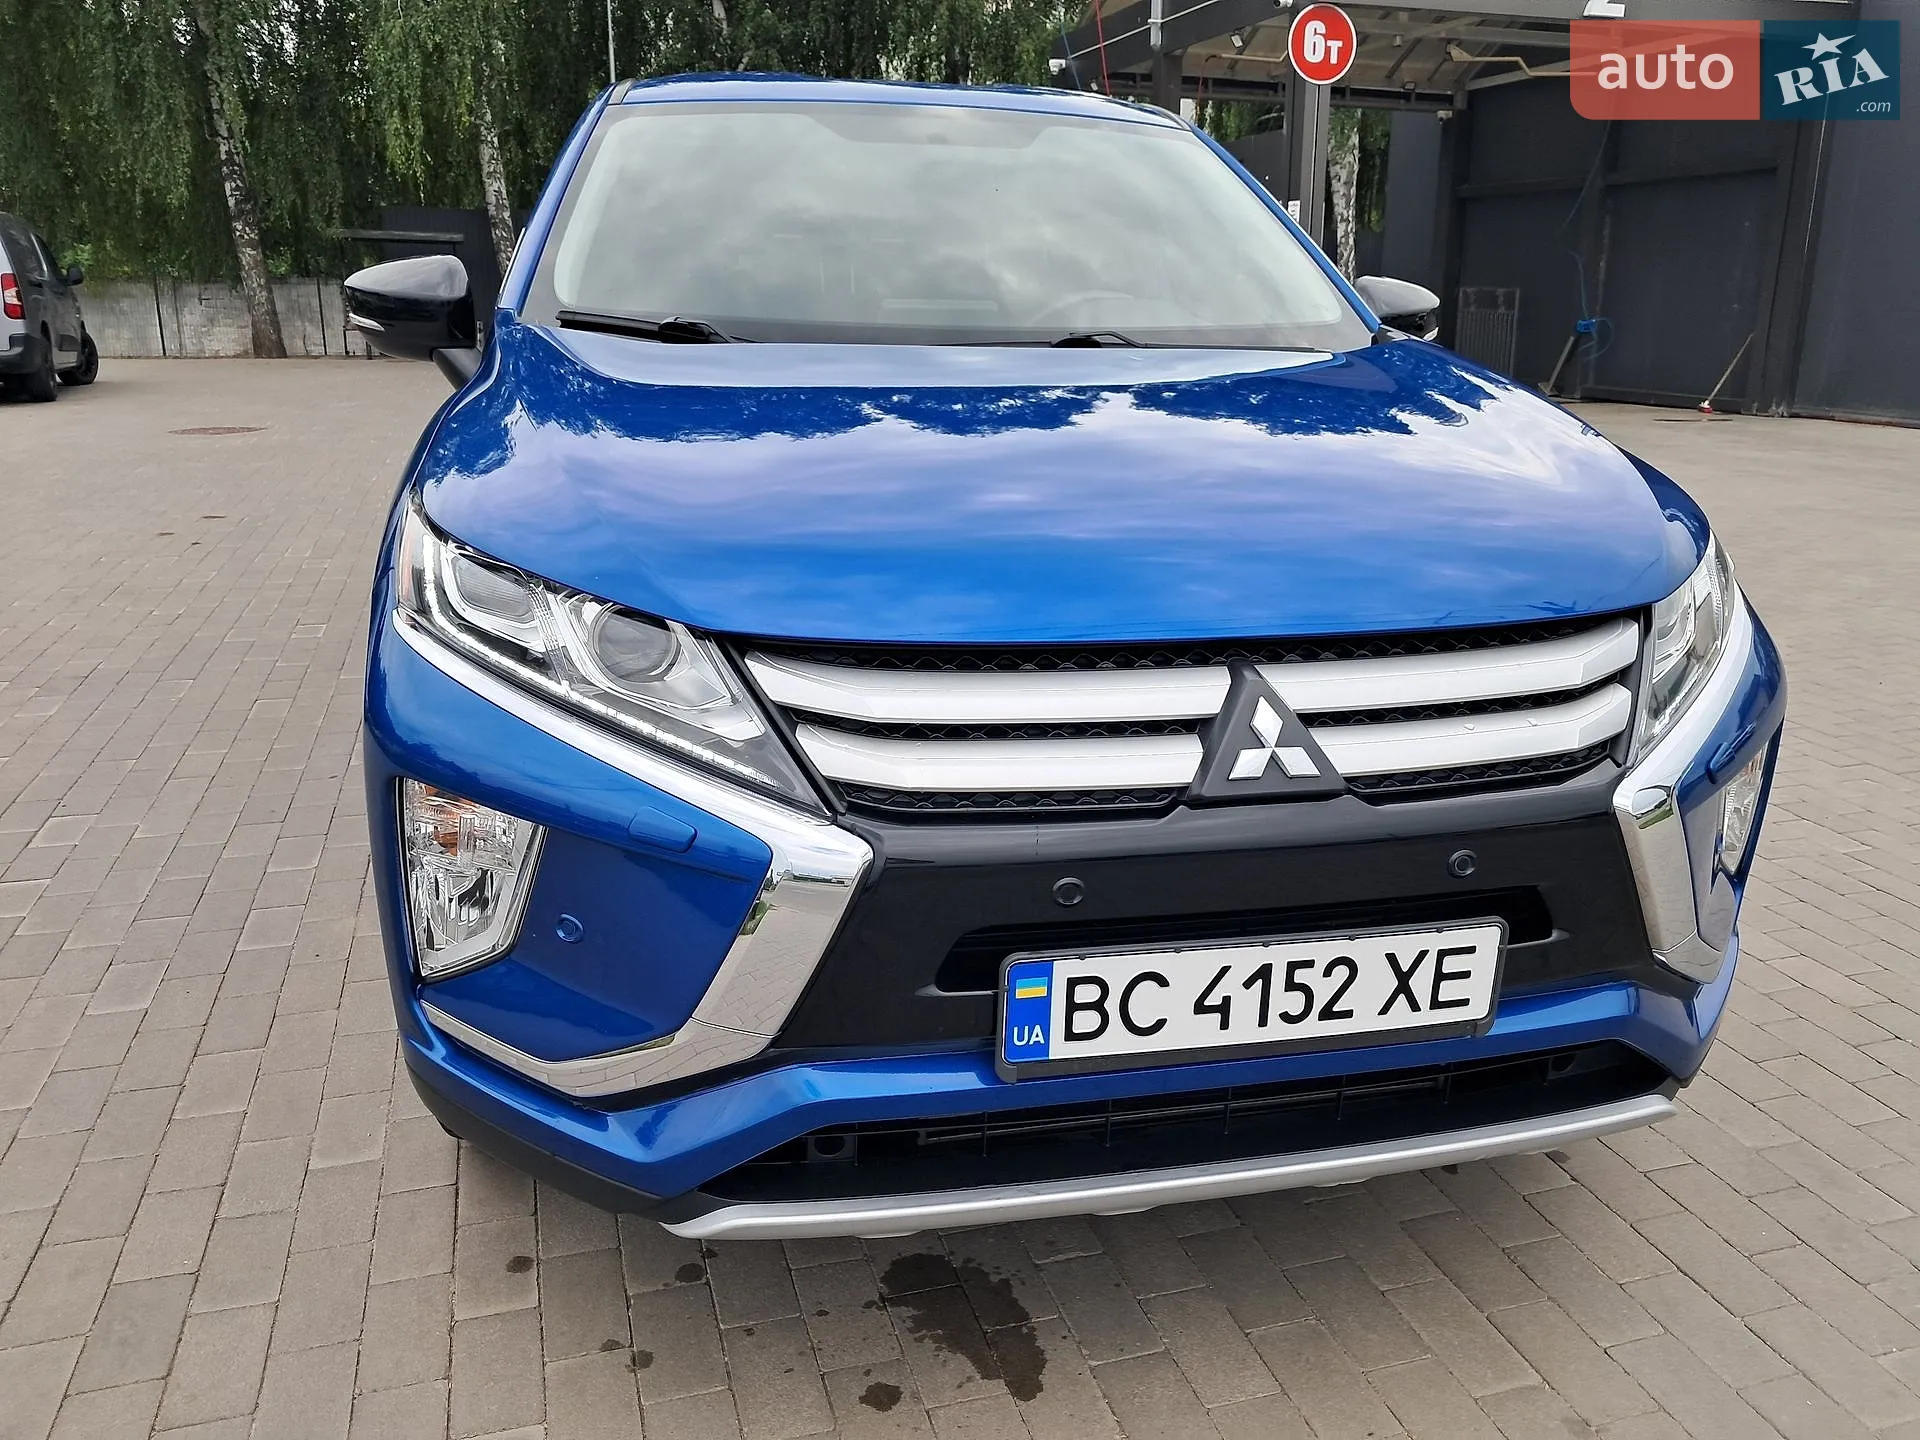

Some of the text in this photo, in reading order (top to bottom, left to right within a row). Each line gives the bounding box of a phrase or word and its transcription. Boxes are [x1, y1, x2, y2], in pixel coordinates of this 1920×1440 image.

[1063, 945, 1478, 1043] BC 4152 XE
[1013, 1024, 1046, 1047] UA
